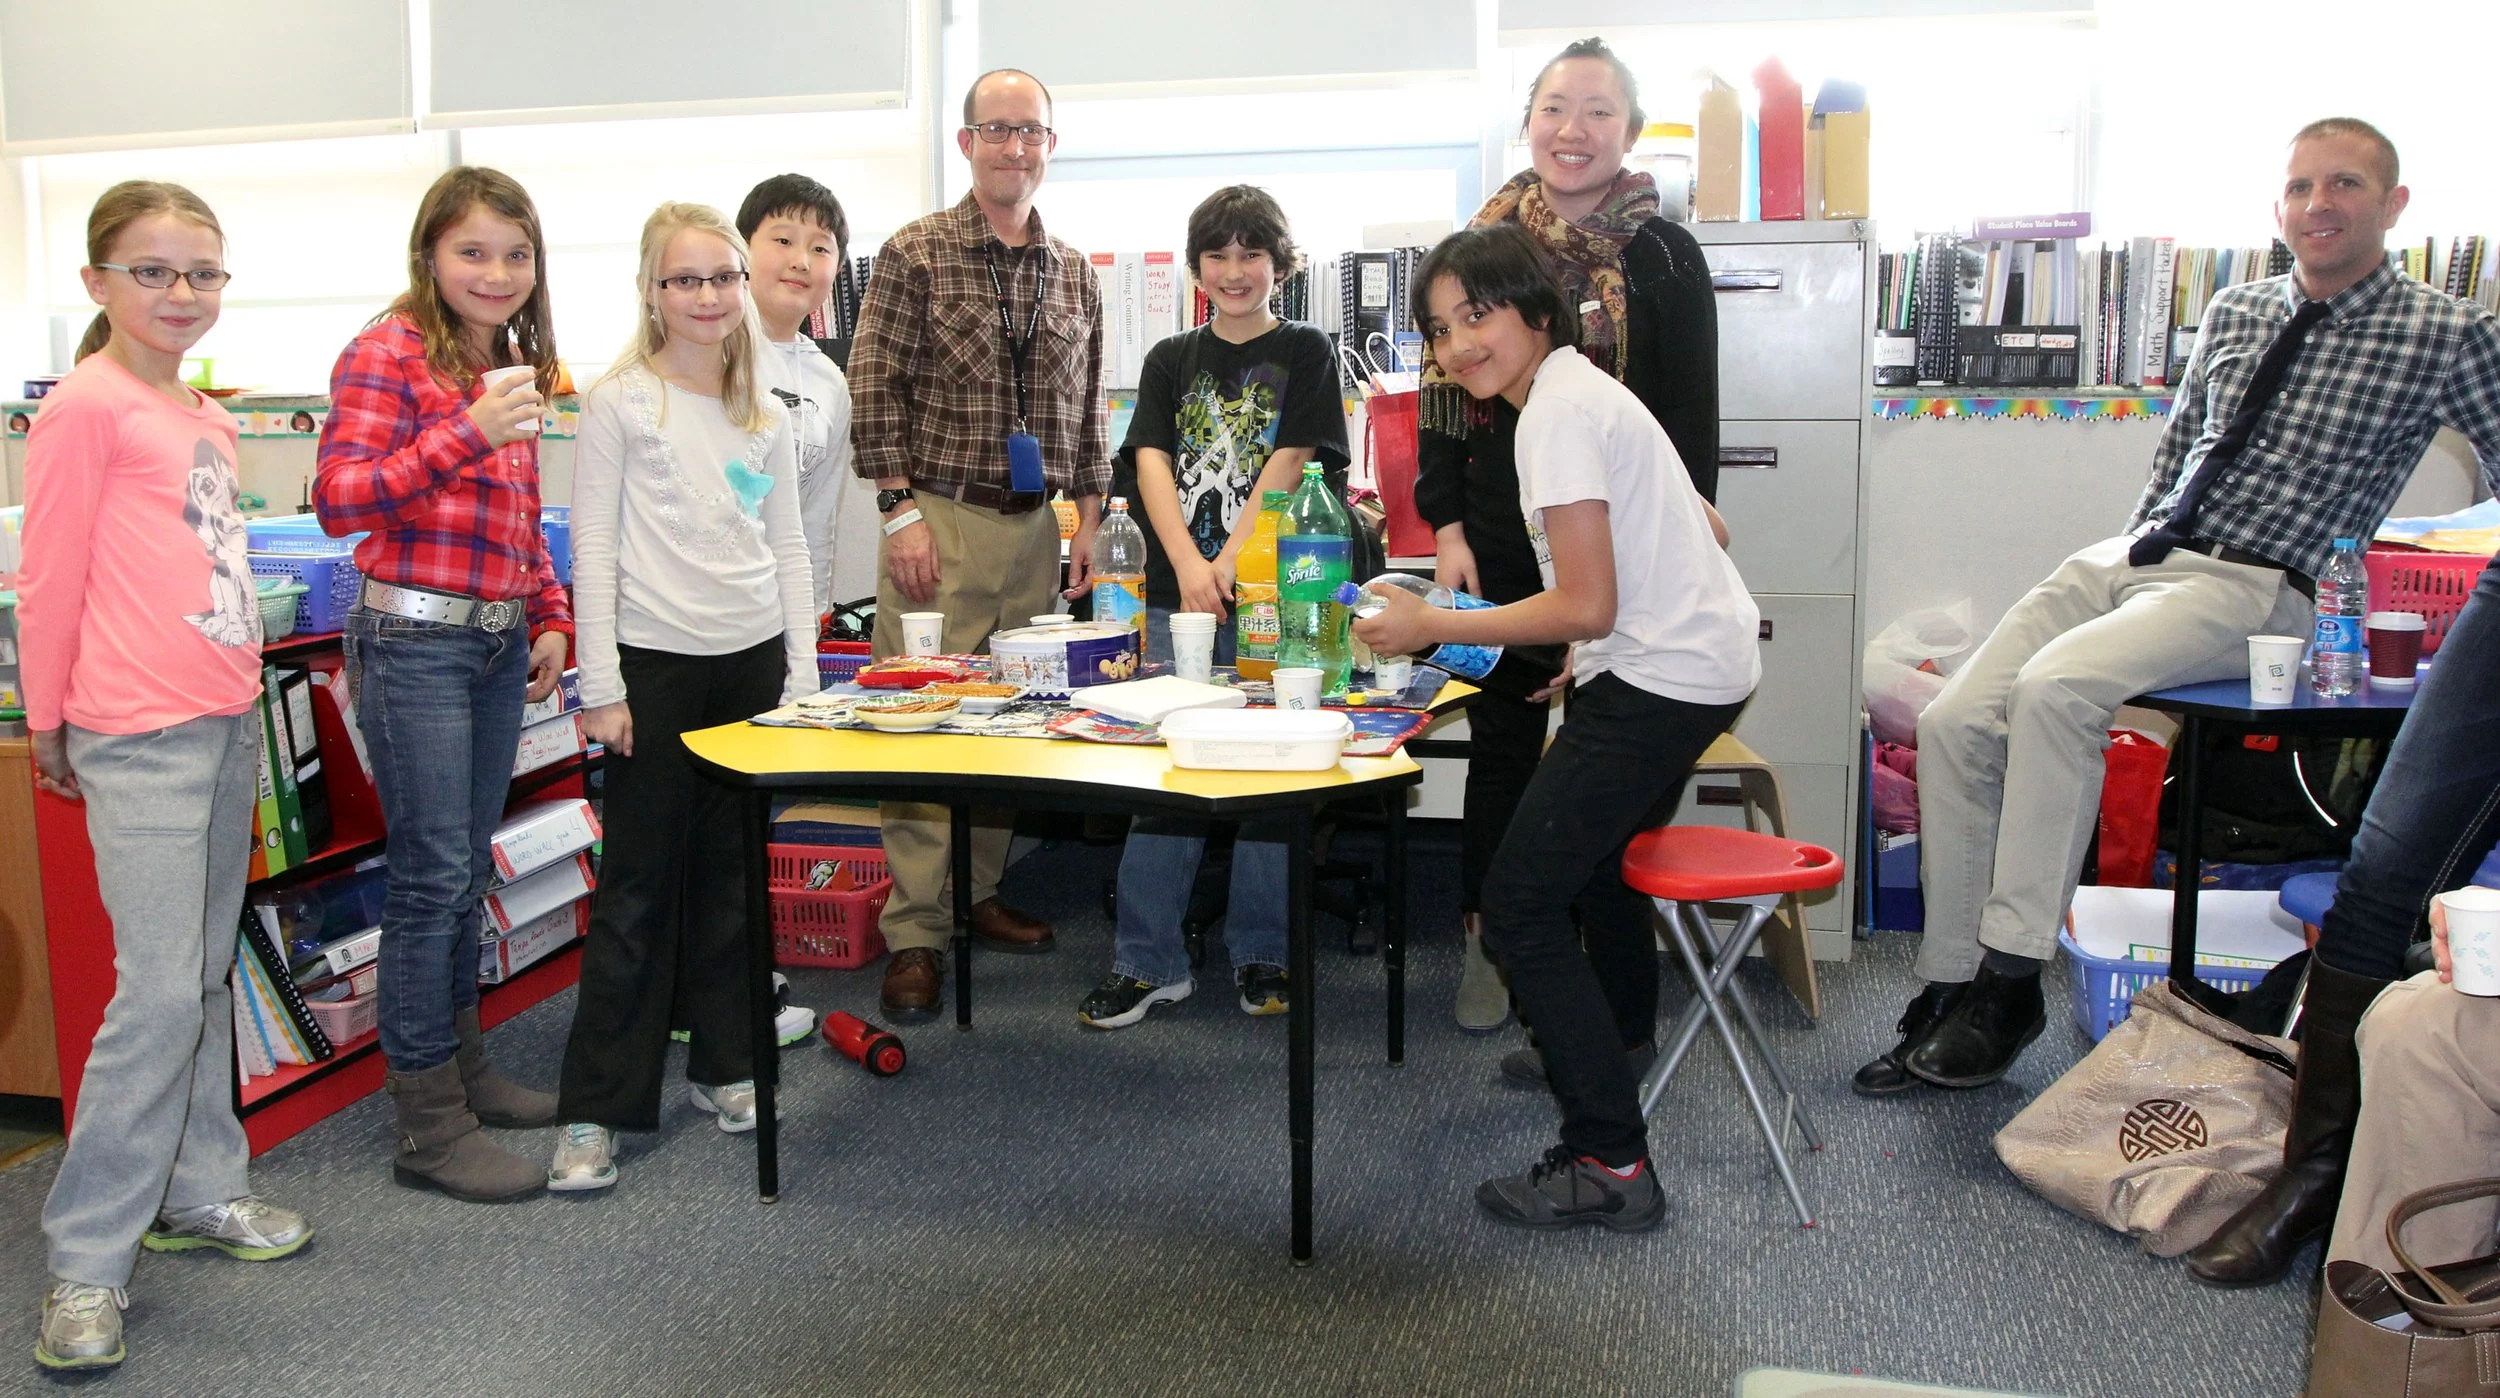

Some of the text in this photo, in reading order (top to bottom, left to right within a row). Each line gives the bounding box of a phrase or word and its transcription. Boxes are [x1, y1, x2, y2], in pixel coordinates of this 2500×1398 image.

[1987, 219, 2078, 229] Student Place Value Boards
[2416, 253, 2424, 281] Learnin
[1123, 262, 1134, 345] Writing Continuum
[2150, 279, 2172, 325] Support
[2147, 331, 2166, 367] Math
[1284, 563, 1321, 585] Sprite
